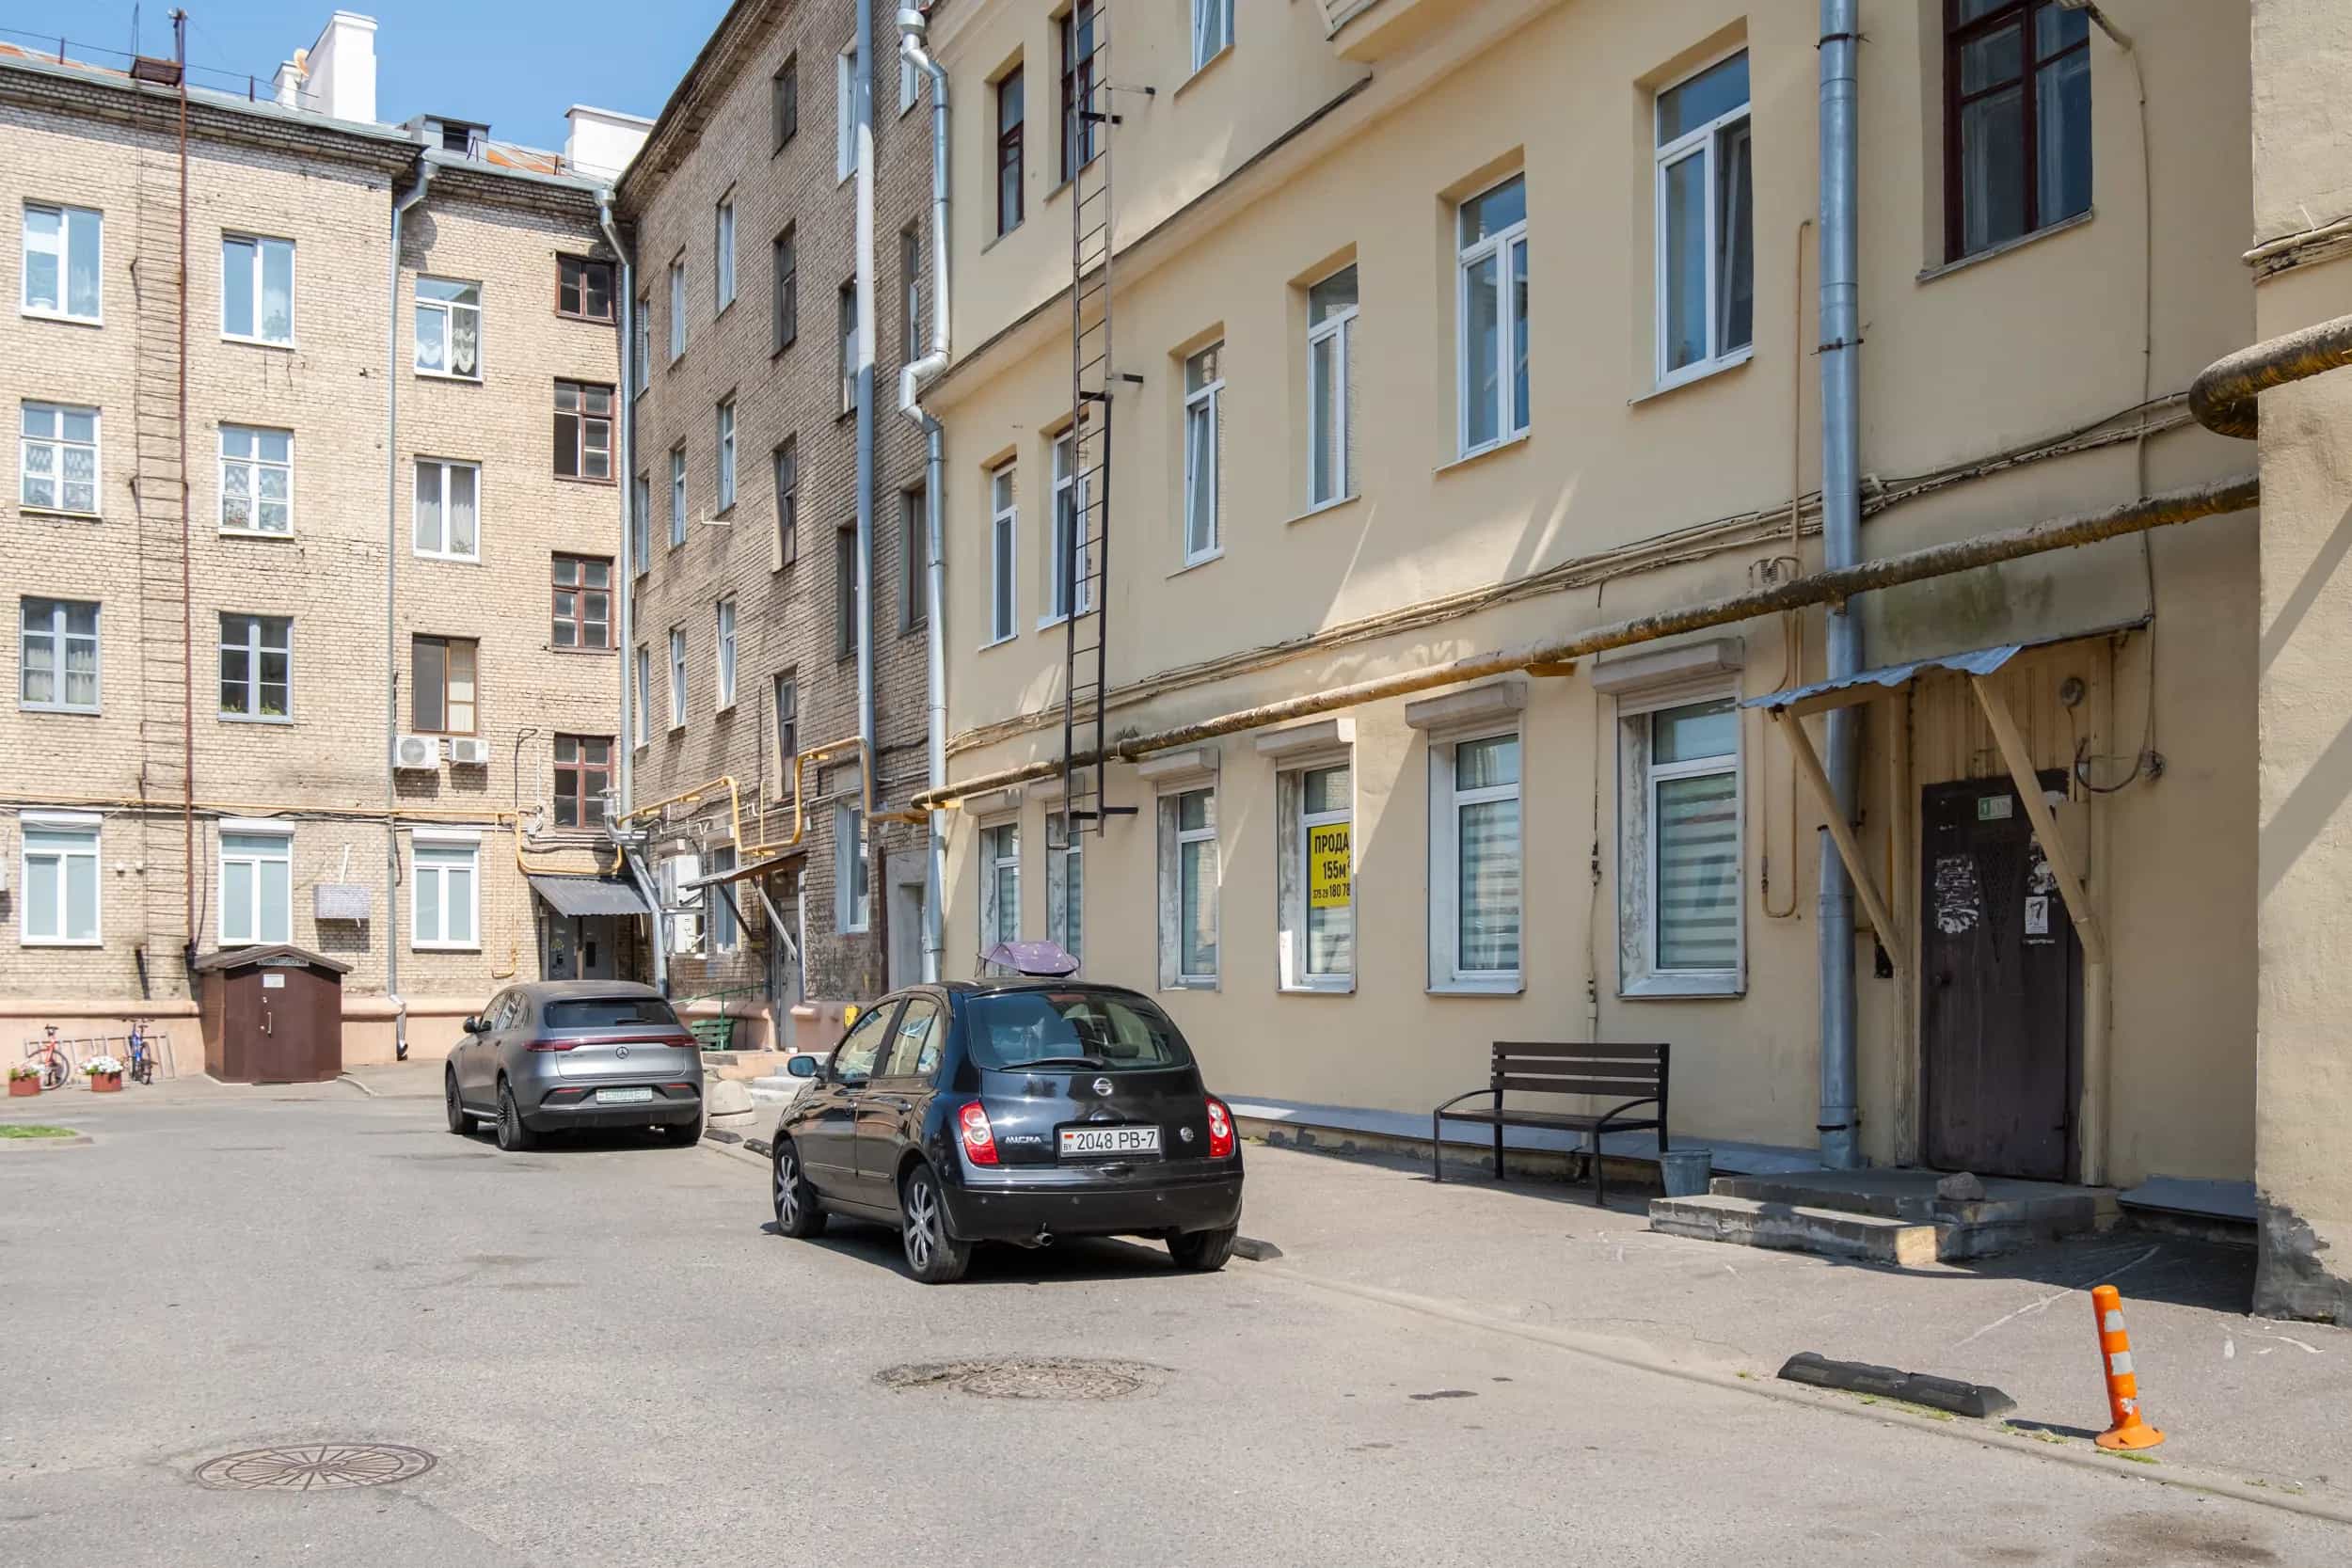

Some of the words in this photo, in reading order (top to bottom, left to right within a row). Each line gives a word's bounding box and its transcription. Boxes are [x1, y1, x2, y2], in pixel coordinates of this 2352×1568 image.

[1314, 832, 1349, 854] ПРОДА
[1329, 884, 1342, 897] 180
[1005, 1135, 1041, 1145] MICRA
[1076, 1132, 1113, 1150] 2048
[1118, 1131, 1156, 1148] PB-7
[1063, 1143, 1073, 1151] BY
